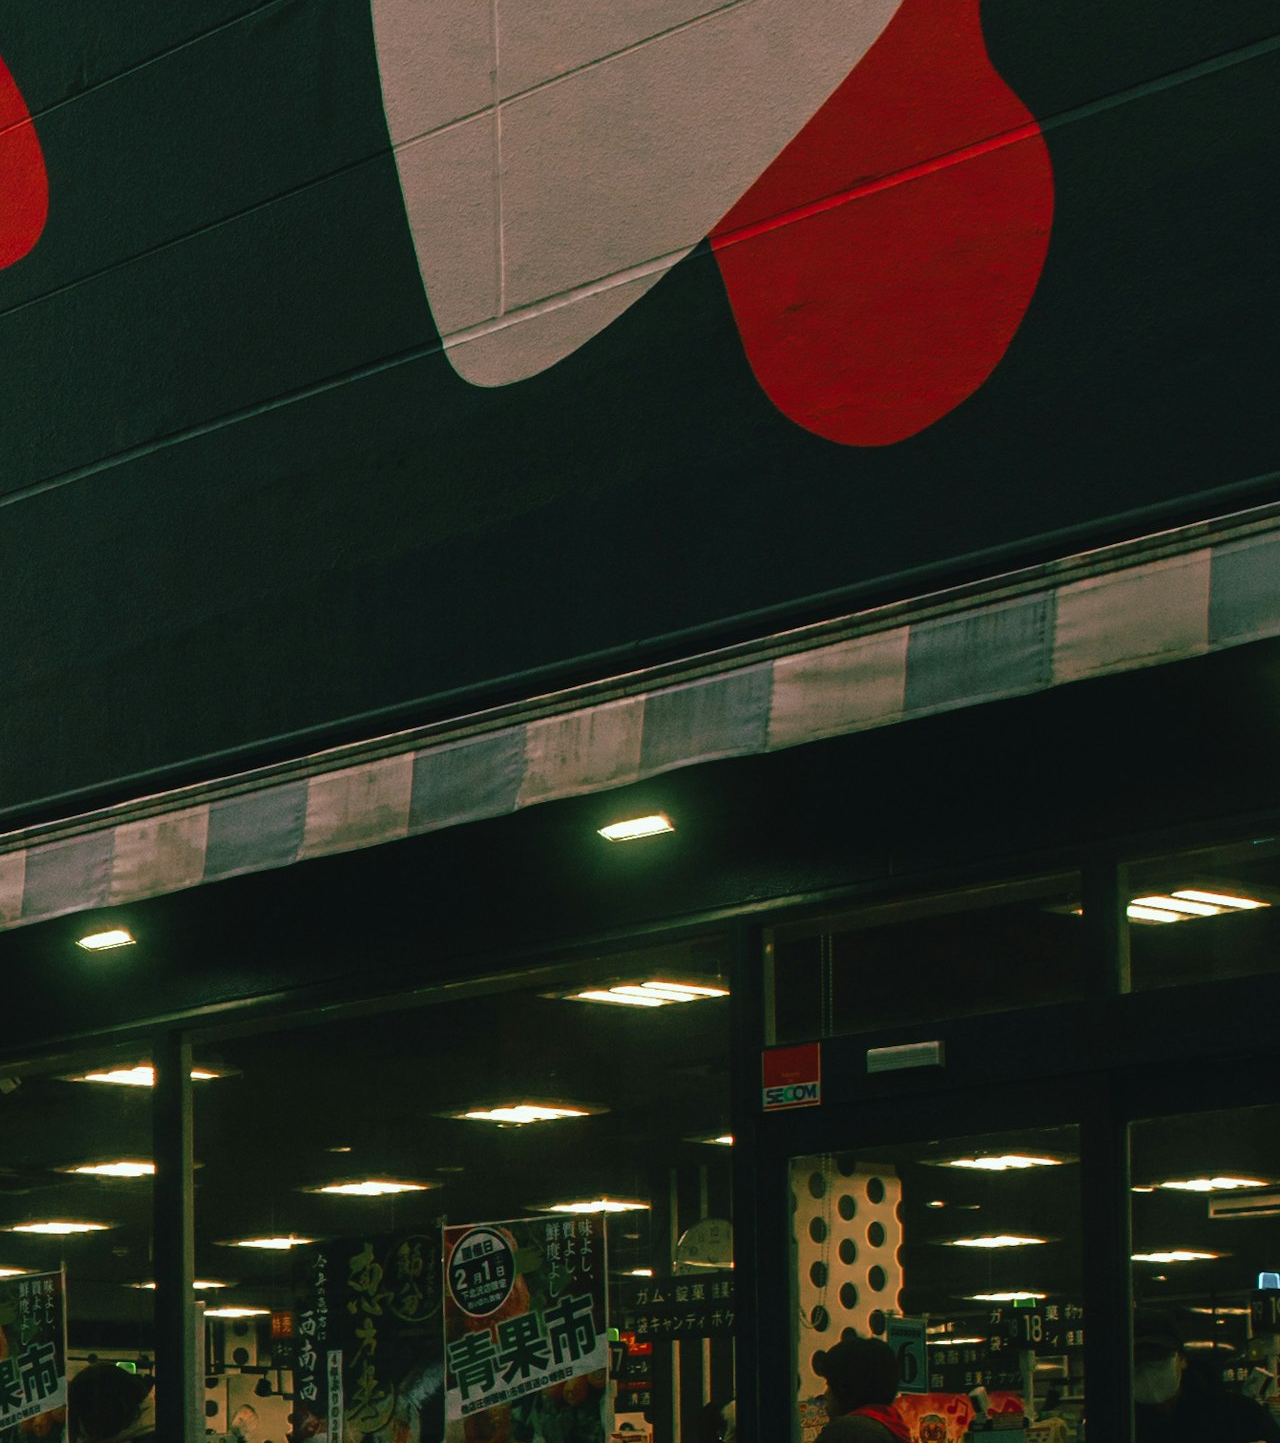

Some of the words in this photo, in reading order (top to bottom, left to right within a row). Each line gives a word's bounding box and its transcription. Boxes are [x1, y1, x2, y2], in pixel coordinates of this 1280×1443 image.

[767, 1083, 817, 1104] SECOM
[545, 1223, 561, 1298] 鮮度よし
[299, 1310, 318, 1401] 西南西
[447, 1293, 597, 1401] 青果市
[1023, 1314, 1044, 1342] 18
[899, 1340, 918, 1384] 6
